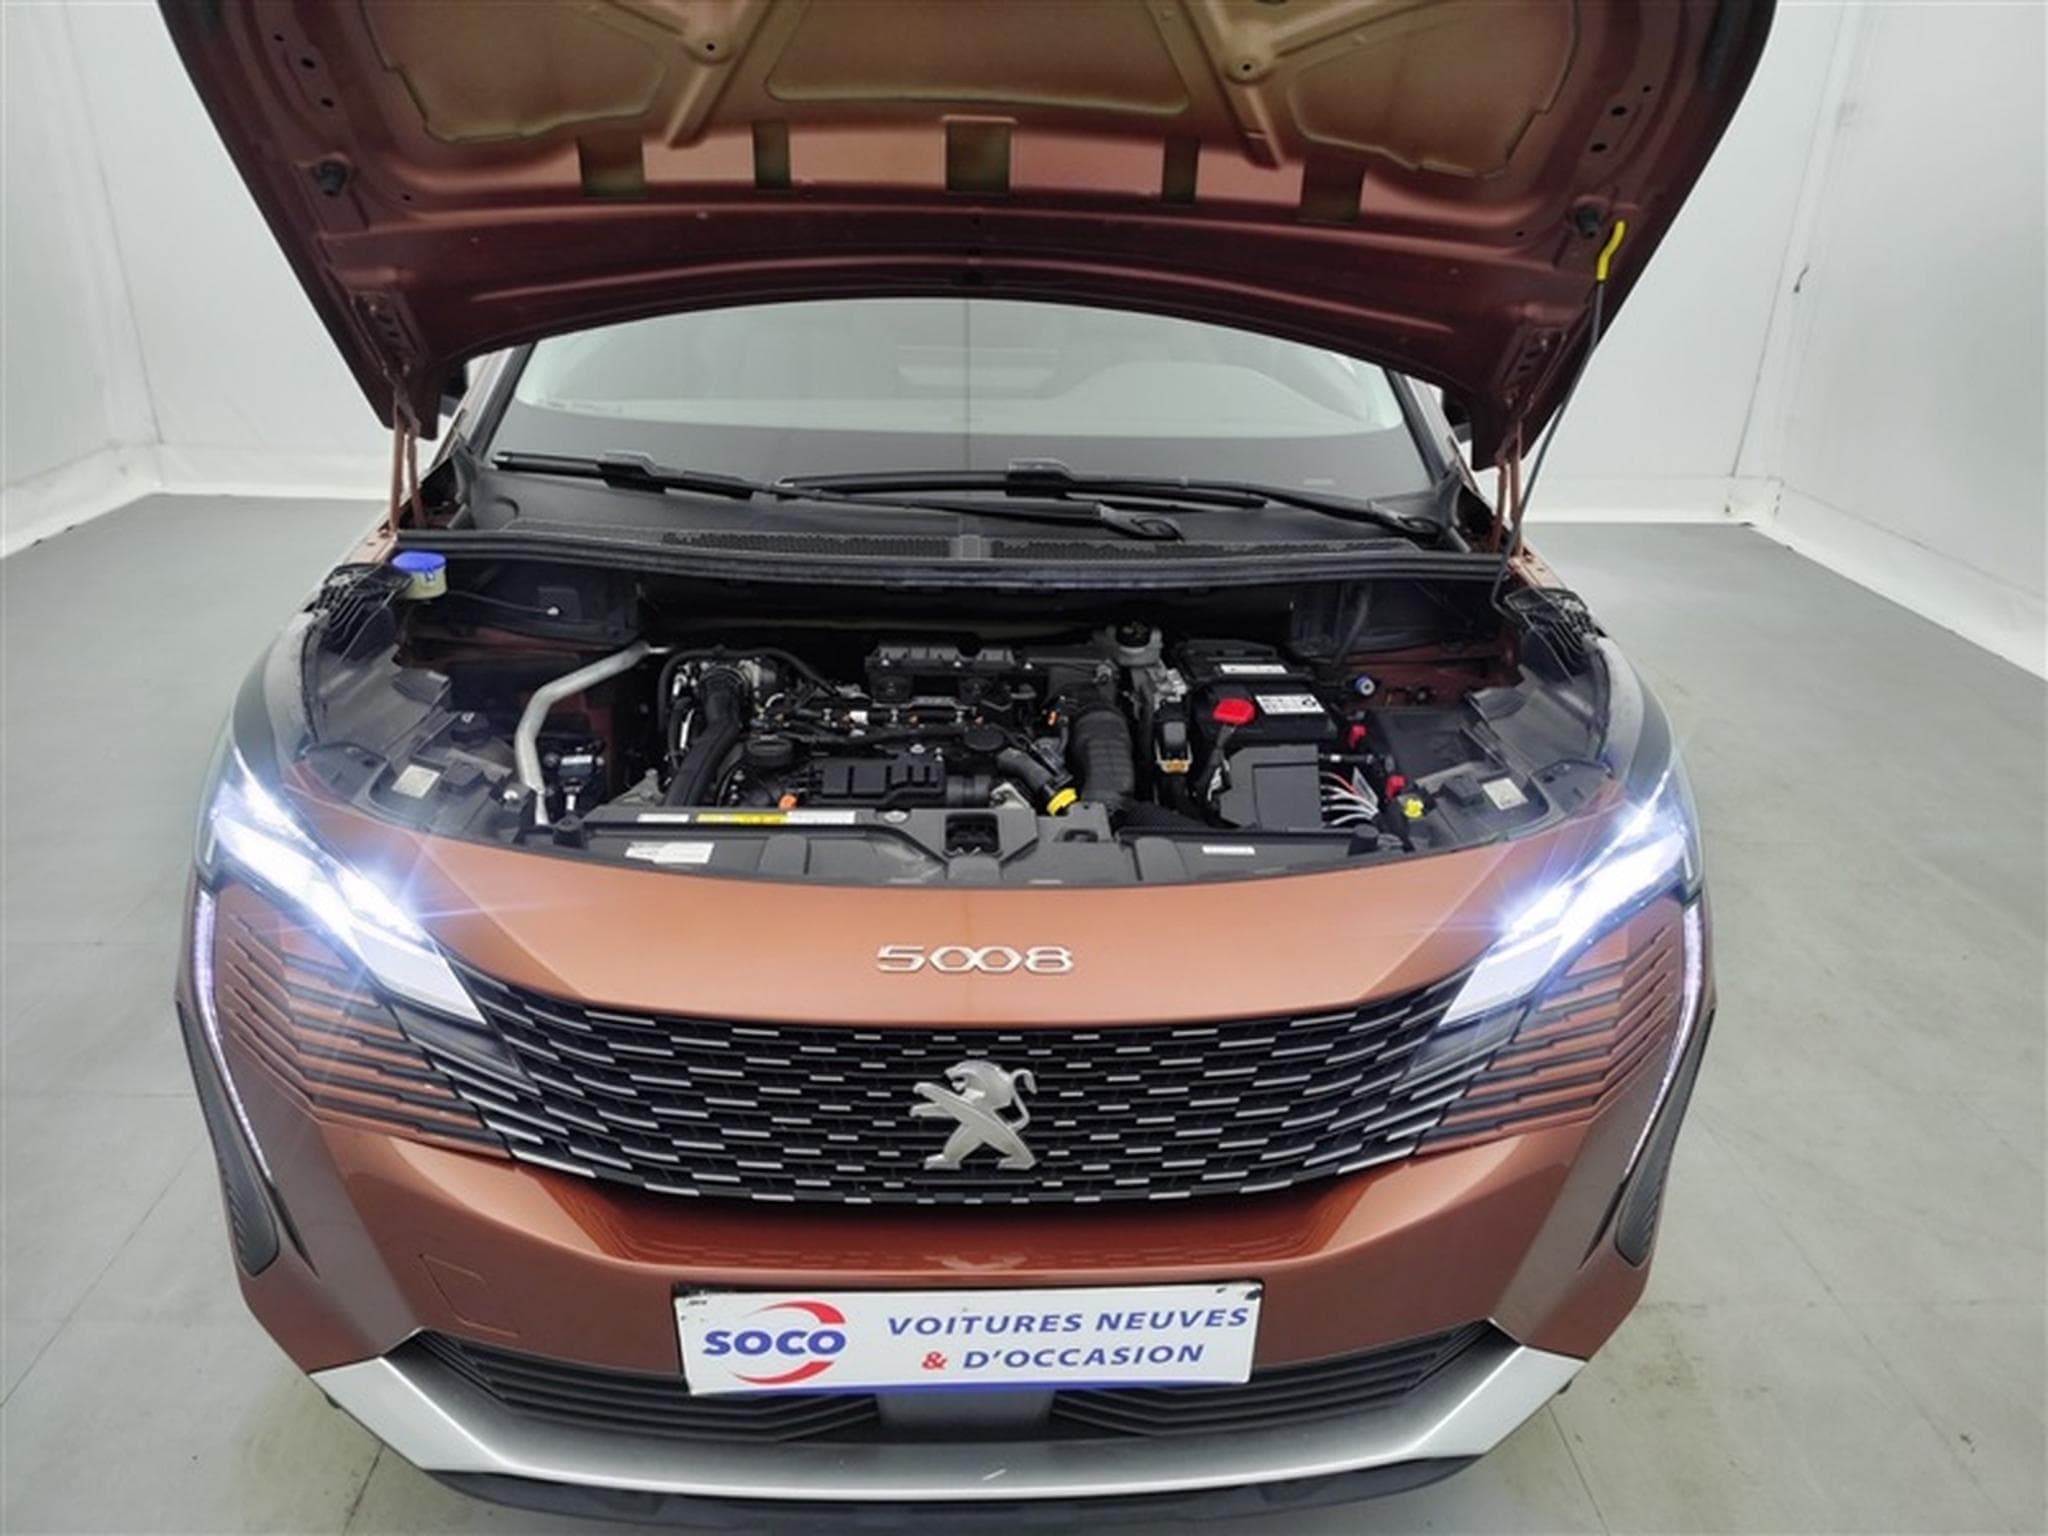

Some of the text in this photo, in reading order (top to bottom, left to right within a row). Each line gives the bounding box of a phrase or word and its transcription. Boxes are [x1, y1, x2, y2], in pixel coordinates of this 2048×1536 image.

[877, 945, 1073, 974] 5008
[888, 1307, 1249, 1336] VOITURES NEUVES
[703, 1330, 846, 1356] SOCO
[922, 1351, 948, 1370] &
